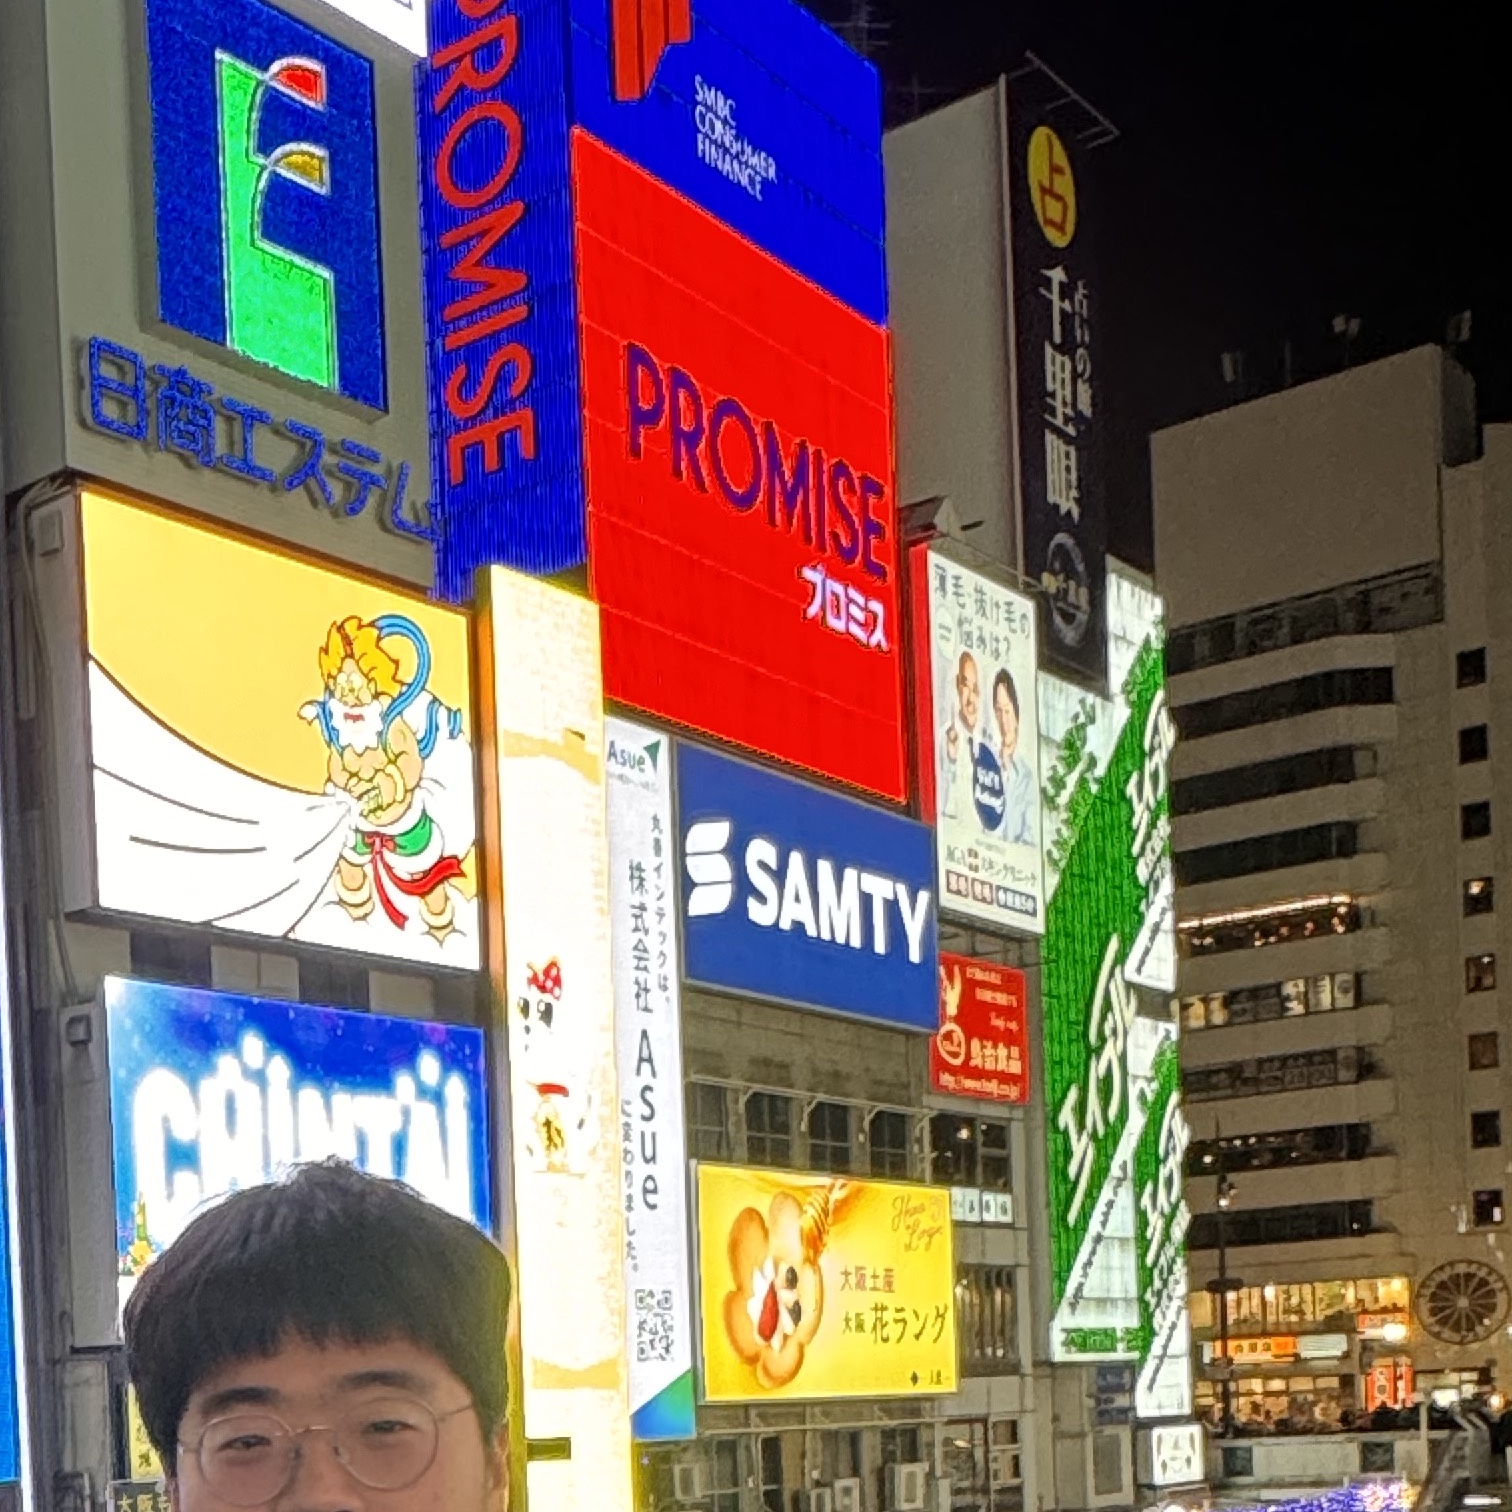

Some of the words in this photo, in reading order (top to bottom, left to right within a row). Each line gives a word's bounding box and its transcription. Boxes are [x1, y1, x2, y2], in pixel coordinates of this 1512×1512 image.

[694, 73, 737, 128] SMBC
[694, 104, 778, 185] CONSUMER
[696, 132, 763, 202] FINANCE
[430, 0, 536, 486] ROMISE
[1039, 264, 1080, 525] 千里眼
[625, 341, 889, 582] PROMISE
[800, 563, 890, 652] プロミス
[606, 739, 646, 775] Asue
[629, 858, 653, 1014] 株式会社
[745, 837, 930, 965] SAMTY
